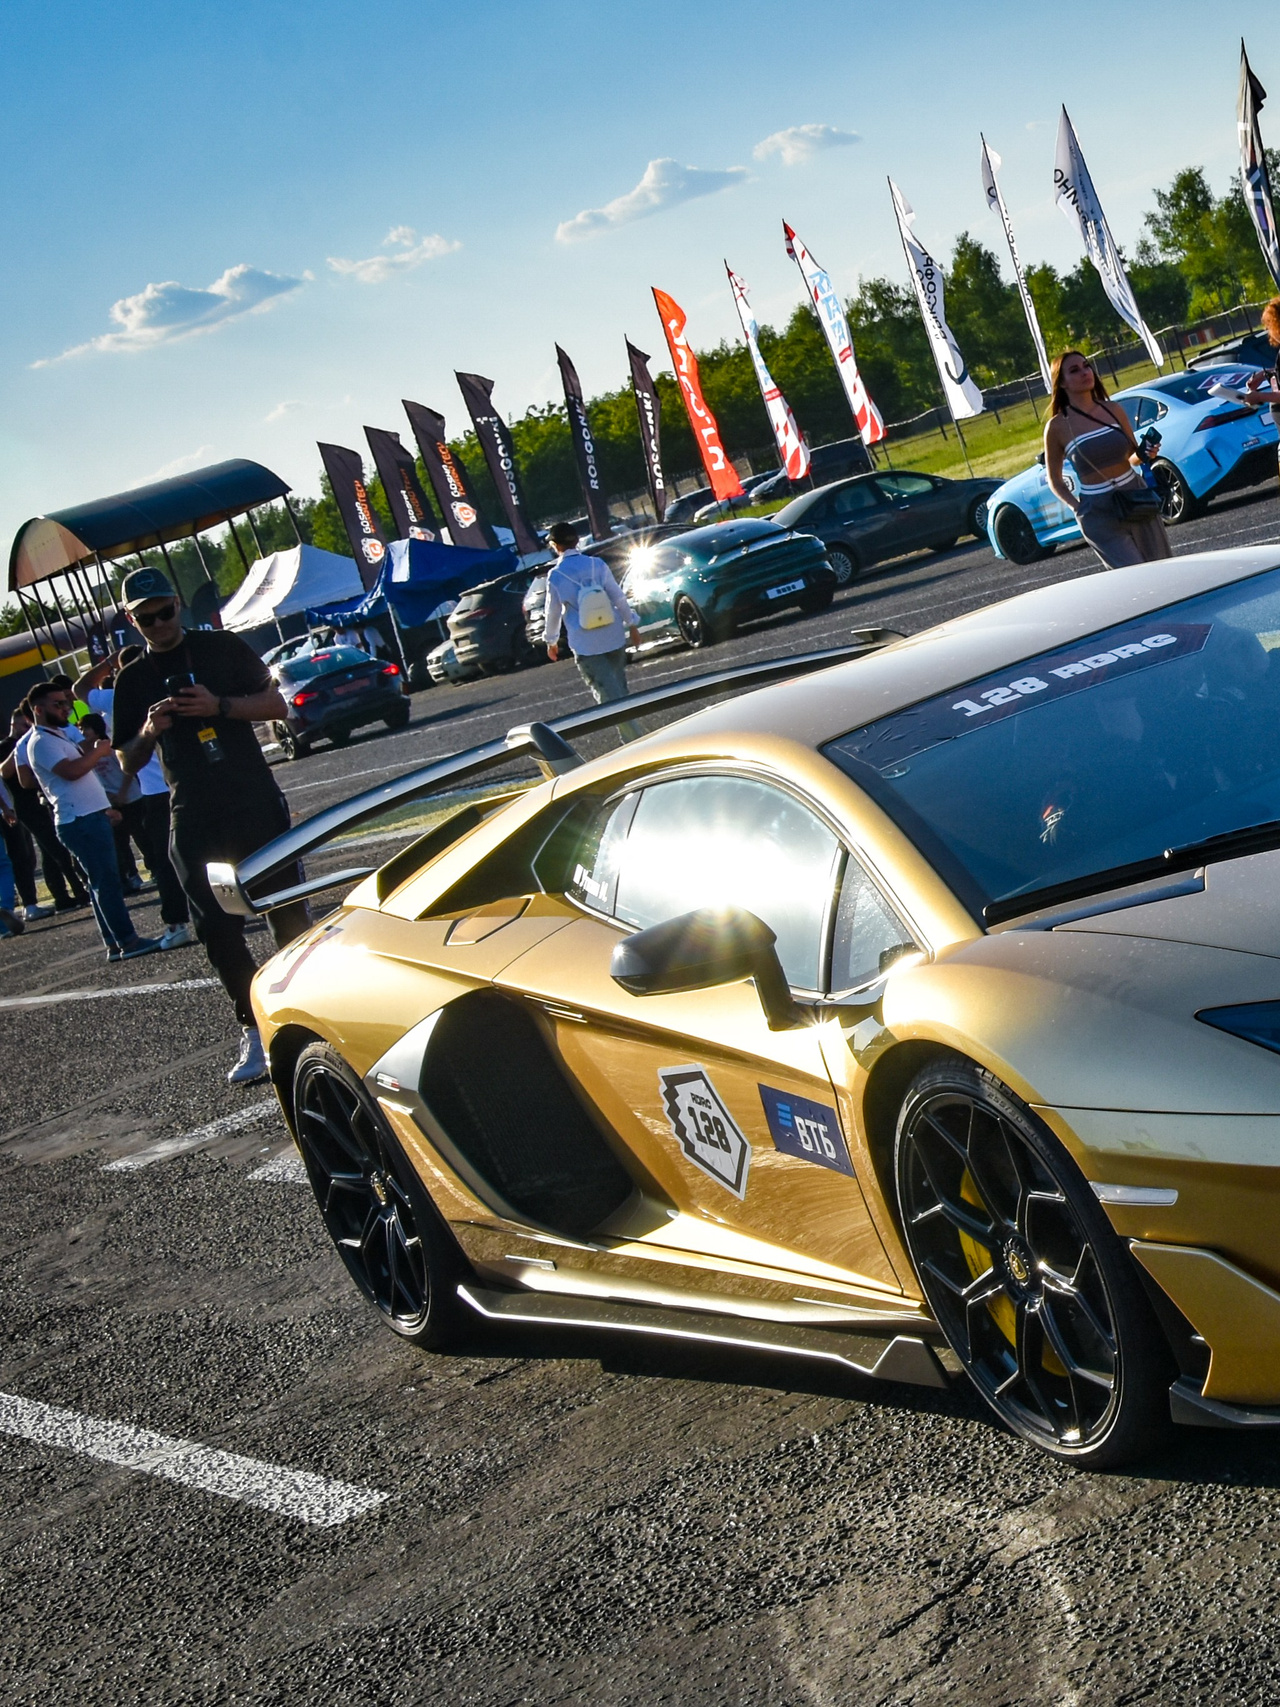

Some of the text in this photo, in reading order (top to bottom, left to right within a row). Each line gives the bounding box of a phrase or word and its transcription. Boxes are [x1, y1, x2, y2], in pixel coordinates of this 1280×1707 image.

[952, 676, 1049, 717] 128
[690, 1092, 712, 1110] RDRC
[687, 1106, 732, 1154] 128
[794, 1115, 837, 1160] ВТБ
